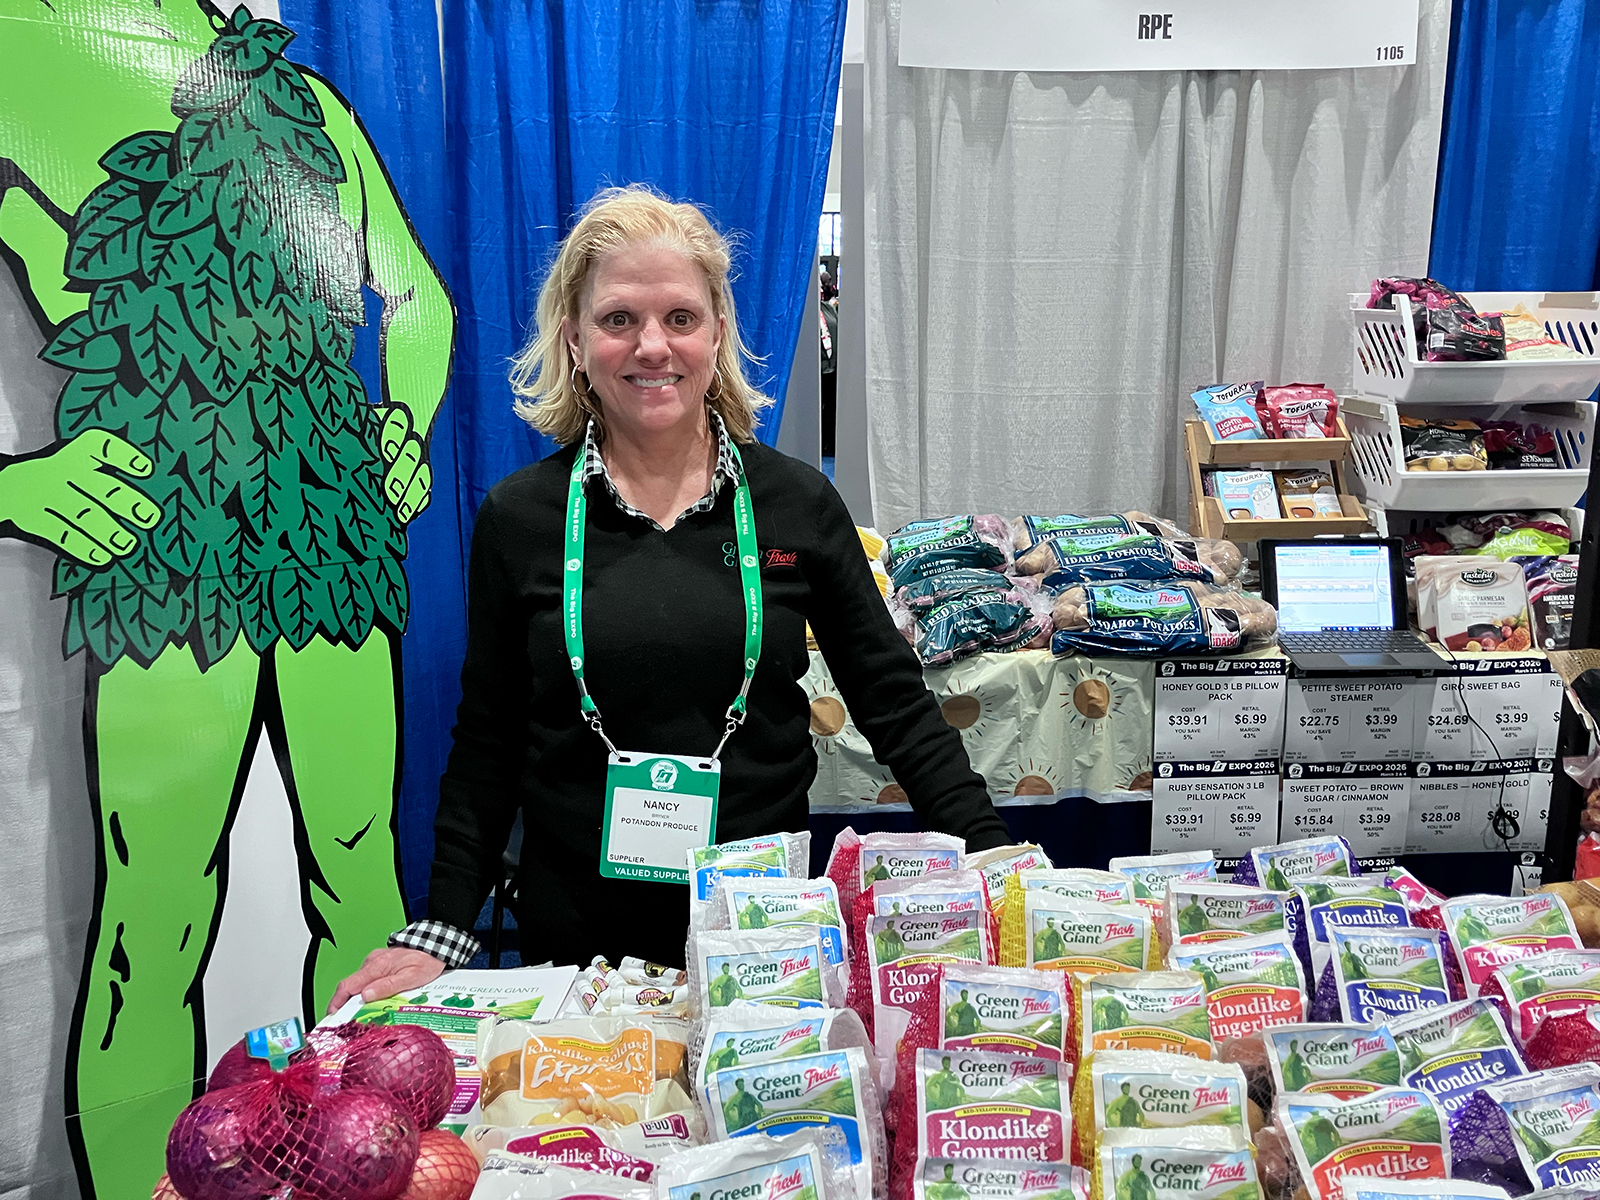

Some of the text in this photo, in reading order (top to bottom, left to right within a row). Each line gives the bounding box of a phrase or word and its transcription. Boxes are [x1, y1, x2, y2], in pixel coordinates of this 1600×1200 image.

[1138, 14, 1173, 40] RPE
[1376, 45, 1404, 60] 1105
[1216, 382, 1249, 401] TOFURKY
[1285, 400, 1323, 414] TOFURKY
[1230, 472, 1264, 483] TOFURKY
[1290, 474, 1323, 485] TOFURKY
[1076, 526, 1126, 537] POTATOES
[919, 531, 974, 551] POTATOES
[763, 549, 798, 569] Fresh
[1063, 546, 1158, 566] IDAHO POTATOES
[1462, 570, 1494, 580] Tasteful
[1157, 591, 1186, 606] Fresh
[1142, 616, 1197, 632] POTATOES
[1181, 661, 1281, 671] The Big EXPO 2026
[1460, 662, 1475, 671] Big
[1494, 661, 1518, 669] EXPO
[1162, 683, 1194, 691] HONEY
[1196, 683, 1221, 691] GOLD
[1245, 682, 1280, 690] PILLOW
[1302, 682, 1403, 692] PETITE SWEET POTATO
[1441, 681, 1521, 691] GIRO SWEET BAG
[1208, 693, 1233, 701] PACK
[1330, 693, 1373, 702] STEAMER
[1168, 714, 1208, 727] $39.91
[1234, 713, 1267, 725] $6.99
[1299, 715, 1339, 727] $22.75
[1365, 714, 1398, 726] $3.99
[1428, 714, 1469, 727] $24.69
[1495, 712, 1528, 725] $3.99
[1196, 763, 1210, 772] Big
[1254, 761, 1275, 769] 2026
[1326, 765, 1340, 773] Big
[1385, 763, 1407, 771] 2026
[1455, 763, 1470, 771] Big
[1168, 783, 1193, 791] RUBY
[1194, 782, 1244, 791] SENSATION
[1253, 781, 1265, 789] LB
[1290, 783, 1404, 793] SWEET POTATO BROWN
[1419, 779, 1529, 791] NIBBLES HONEY GOLD
[1186, 792, 1246, 801] PILLOW PACK
[1303, 793, 1389, 802] SUGAR CINNAMON
[643, 799, 680, 812] NANCY
[620, 816, 661, 828] POTANDON
[662, 821, 699, 832] PRODUCE
[1165, 814, 1204, 825] $39.91
[1229, 812, 1262, 824] $6.99
[1294, 814, 1334, 827] $15.84
[1358, 813, 1391, 825] $3.99
[1420, 811, 1461, 823] $28.08
[609, 853, 645, 864] SUPPLIER
[1280, 849, 1338, 868] Green Fresh
[888, 857, 952, 875] Green Fresh
[890, 867, 922, 877] Giant
[1283, 867, 1313, 878] Giant
[614, 866, 651, 878] VALUED
[653, 870, 690, 881] SUPPLIE
[1204, 896, 1276, 917] Green Fresh
[1206, 908, 1242, 920] Giant
[1319, 909, 1399, 926] Klondike
[900, 917, 969, 936] Green Fresh
[1061, 920, 1135, 943] Green Fresh
[901, 931, 939, 943] Giant
[1063, 931, 1101, 944] Giant
[1359, 943, 1428, 964] Green Fresh
[1362, 954, 1400, 967] Giant
[736, 955, 811, 980] Green Fresh
[739, 973, 778, 988] Giant
[469, 986, 502, 994] GREEN
[504, 986, 540, 994] GIANT!
[975, 993, 1052, 1019] Green Fresh
[1357, 988, 1438, 1012] Klondike
[978, 1006, 1020, 1020] Giant
[1207, 995, 1292, 1020] Klondike
[1212, 1014, 1299, 1038] ingerling
[527, 1041, 649, 1063] Klondike Goldust
[1303, 1036, 1388, 1060] Green Fresh
[1306, 1053, 1350, 1067] Giant
[531, 1052, 646, 1089] Express
[959, 1059, 1046, 1084] Green Fresh
[1415, 1060, 1507, 1095] Klondike
[753, 1063, 842, 1095] Green Fresh
[961, 1073, 1008, 1088] Giant
[757, 1088, 803, 1103] Giant
[1139, 1084, 1231, 1112] Green Fresh
[1141, 1098, 1189, 1114] Giant
[1334, 1111, 1381, 1129] Giant
[940, 1119, 1049, 1141] Klondike
[941, 1141, 1050, 1160] Gourmet
[1150, 1158, 1248, 1190] Green Fresh
[1323, 1153, 1431, 1190] Klondike
[1152, 1173, 1202, 1191] Giant
